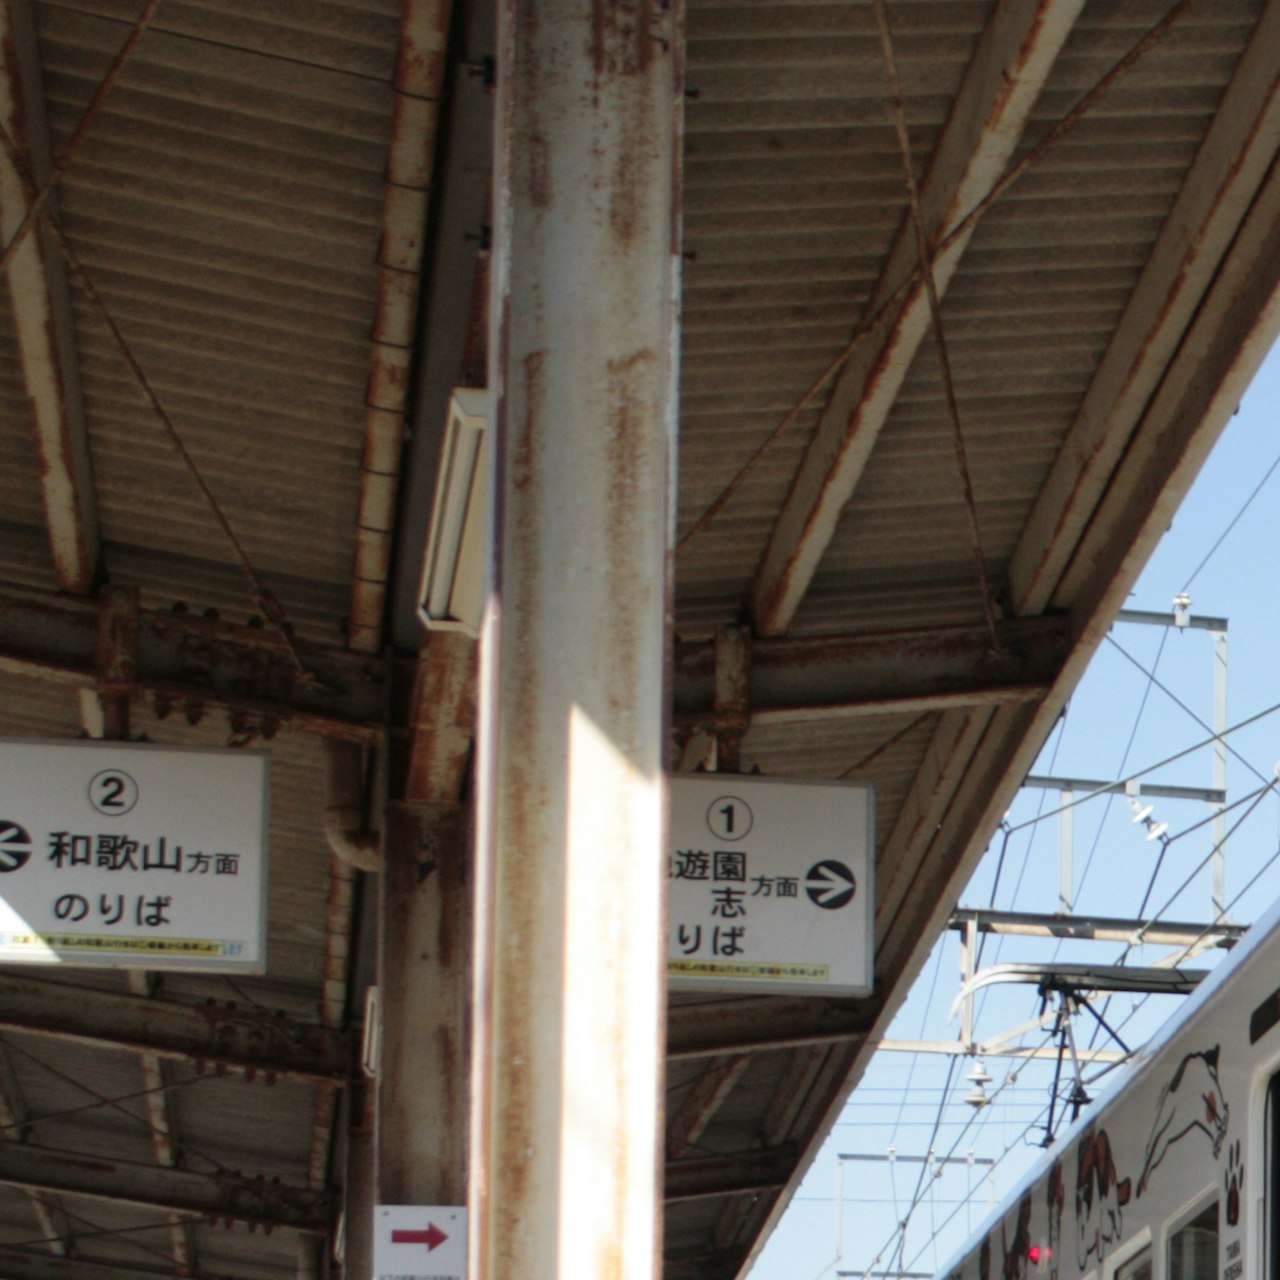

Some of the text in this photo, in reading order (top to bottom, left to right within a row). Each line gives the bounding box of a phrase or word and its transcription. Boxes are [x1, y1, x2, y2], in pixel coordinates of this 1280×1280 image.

[751, 875, 800, 898] 方面
[54, 893, 174, 927] のりば
